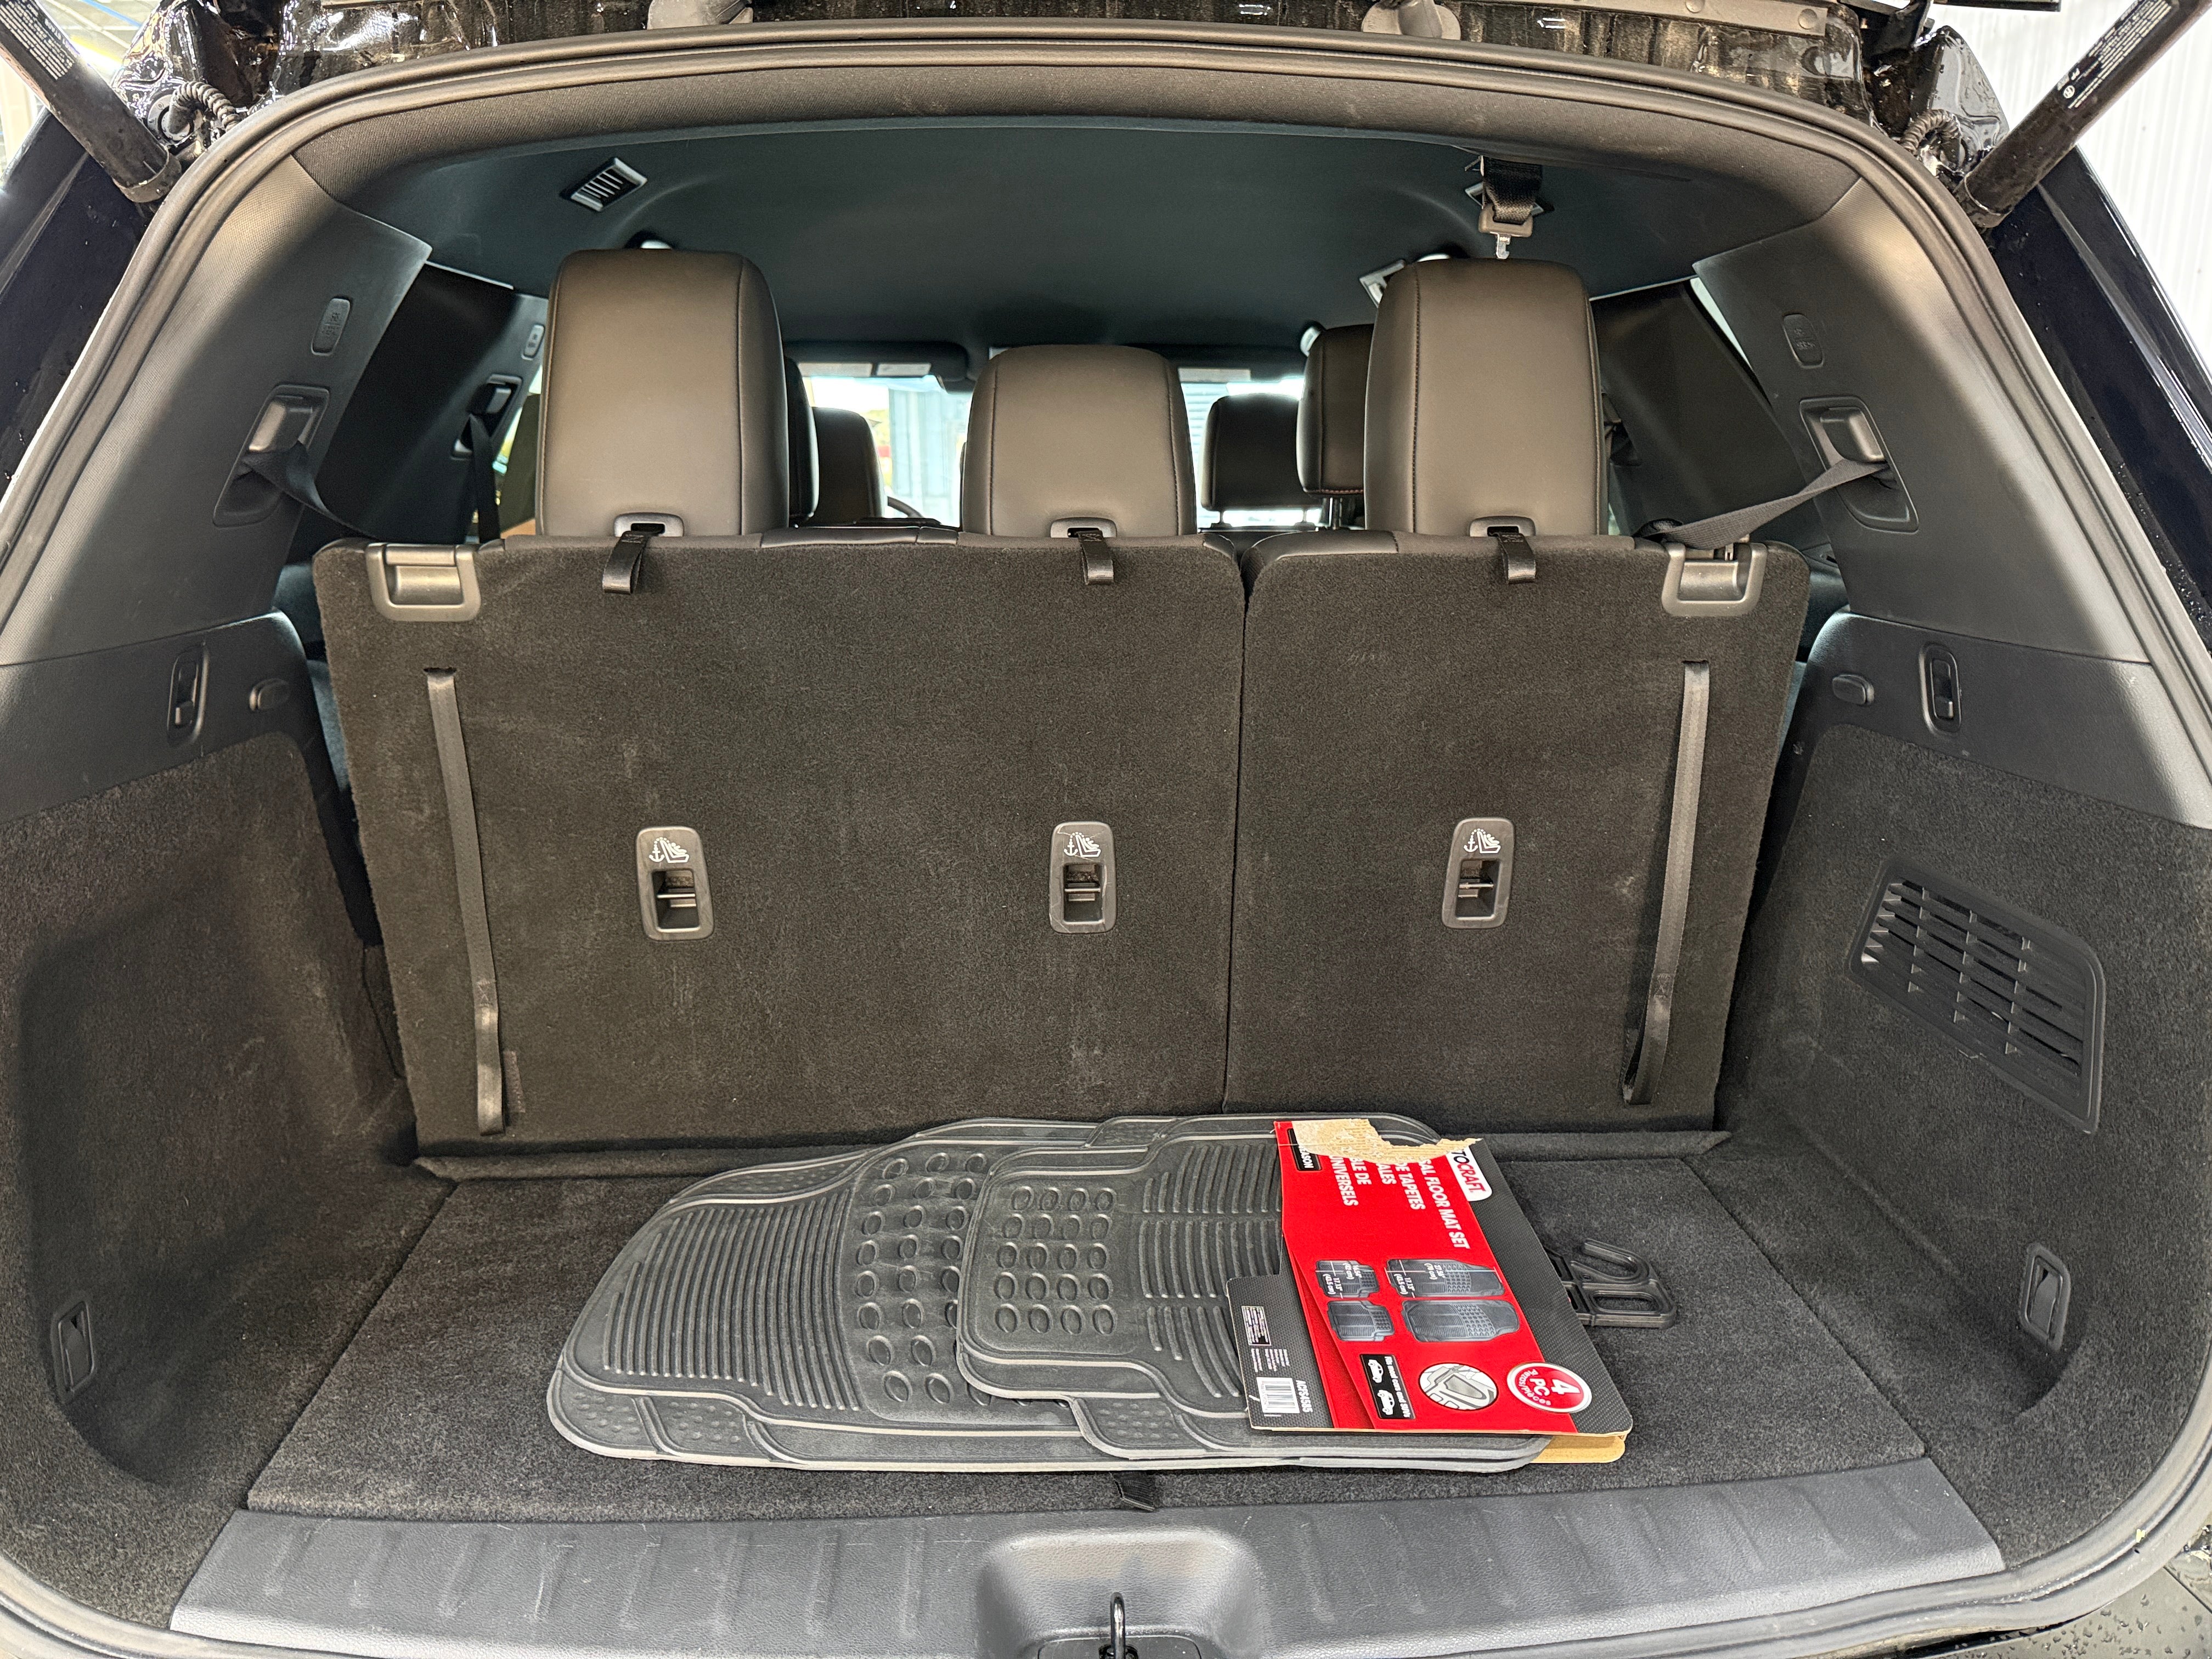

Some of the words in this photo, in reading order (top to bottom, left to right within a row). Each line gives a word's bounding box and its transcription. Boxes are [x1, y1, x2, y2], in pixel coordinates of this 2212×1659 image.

[1328, 1155, 1359, 1206] UNIVERSELS
[1355, 1172, 1372, 1185] DE
[1398, 1172, 1426, 1210] TAPETES
[1424, 1177, 1451, 1207] FLOOR
[1438, 1209, 1462, 1230] MAT
[1448, 1231, 1471, 1249] SET
[1296, 1380, 1313, 1413] ACFS4585
[1529, 1378, 1550, 1396] PC
[1550, 1379, 1581, 1395] 4
[1396, 1391, 1407, 1403] and
